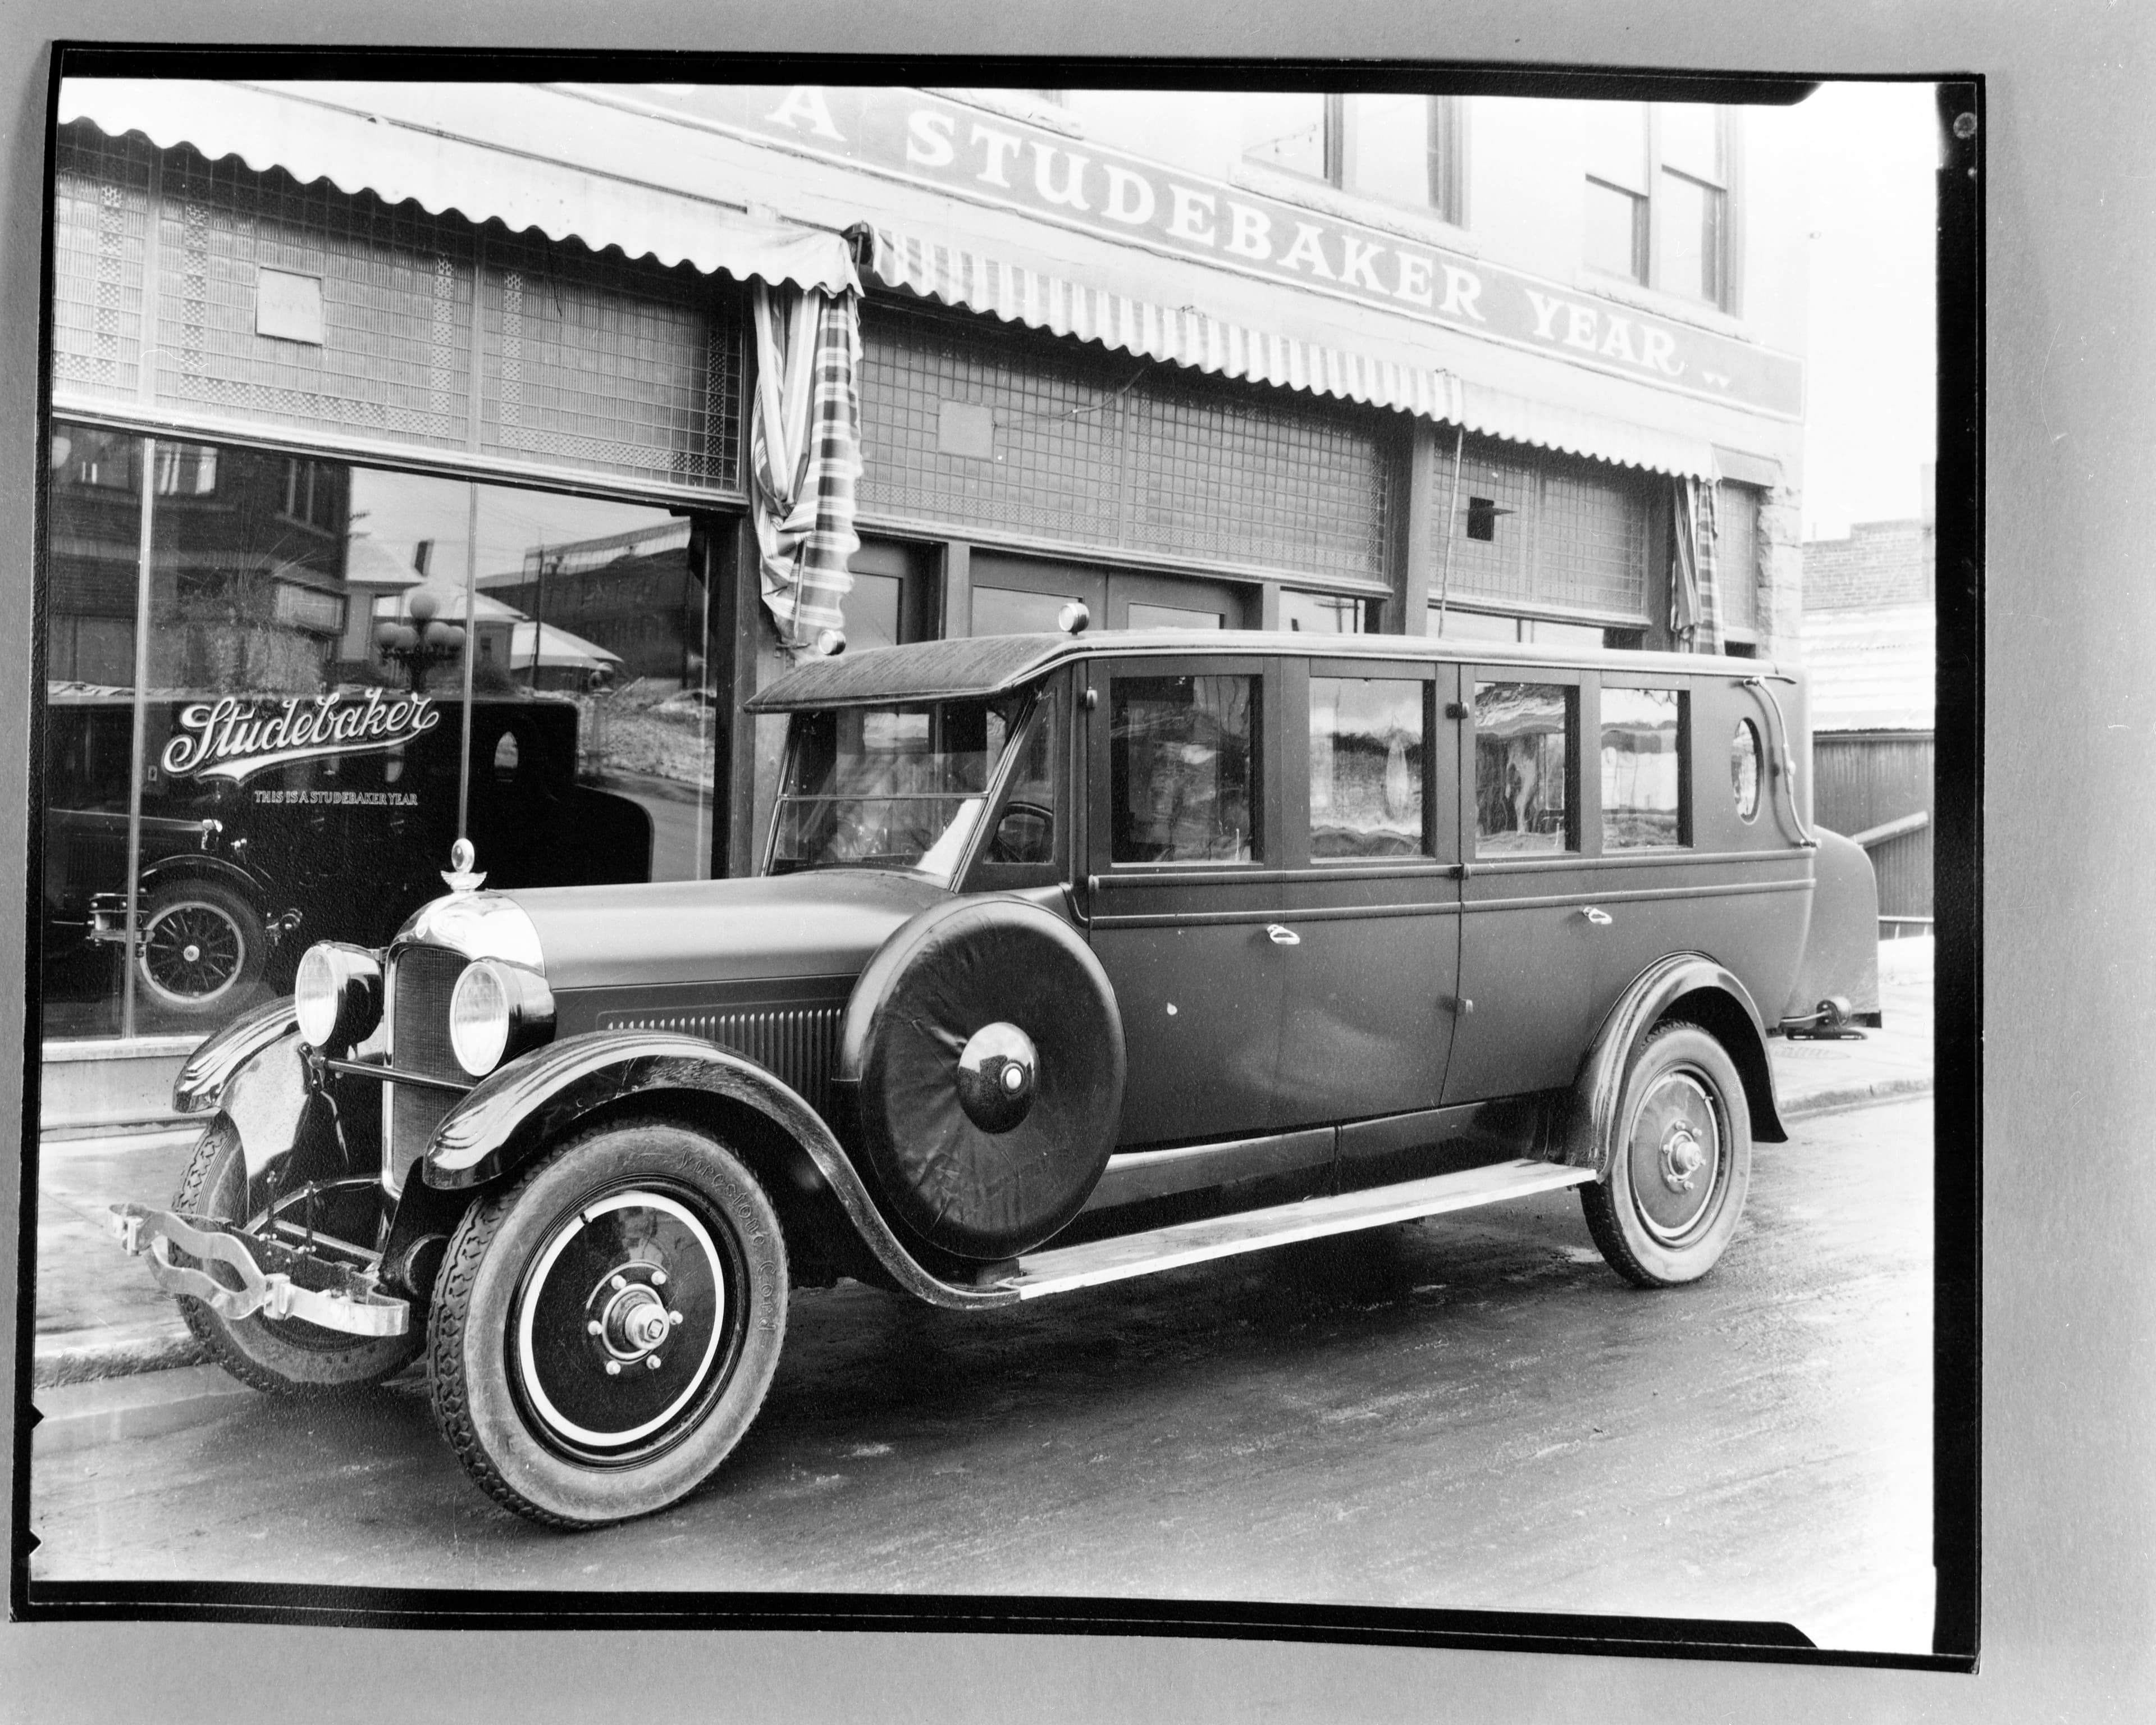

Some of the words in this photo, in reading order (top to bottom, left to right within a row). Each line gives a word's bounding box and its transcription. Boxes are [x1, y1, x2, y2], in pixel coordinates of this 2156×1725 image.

[766, 86, 847, 142] A
[905, 109, 1486, 323] STUDEBAKER
[1524, 284, 1687, 377] YEAR
[162, 688, 440, 773] Studebaker
[255, 791, 283, 803] THIS
[286, 791, 298, 803] IS
[299, 791, 308, 804] A
[310, 791, 387, 805] STUDEBAKER
[388, 793, 418, 805] YEAR
[675, 1145, 770, 1245] Firestone
[758, 1260, 777, 1331] Cord
